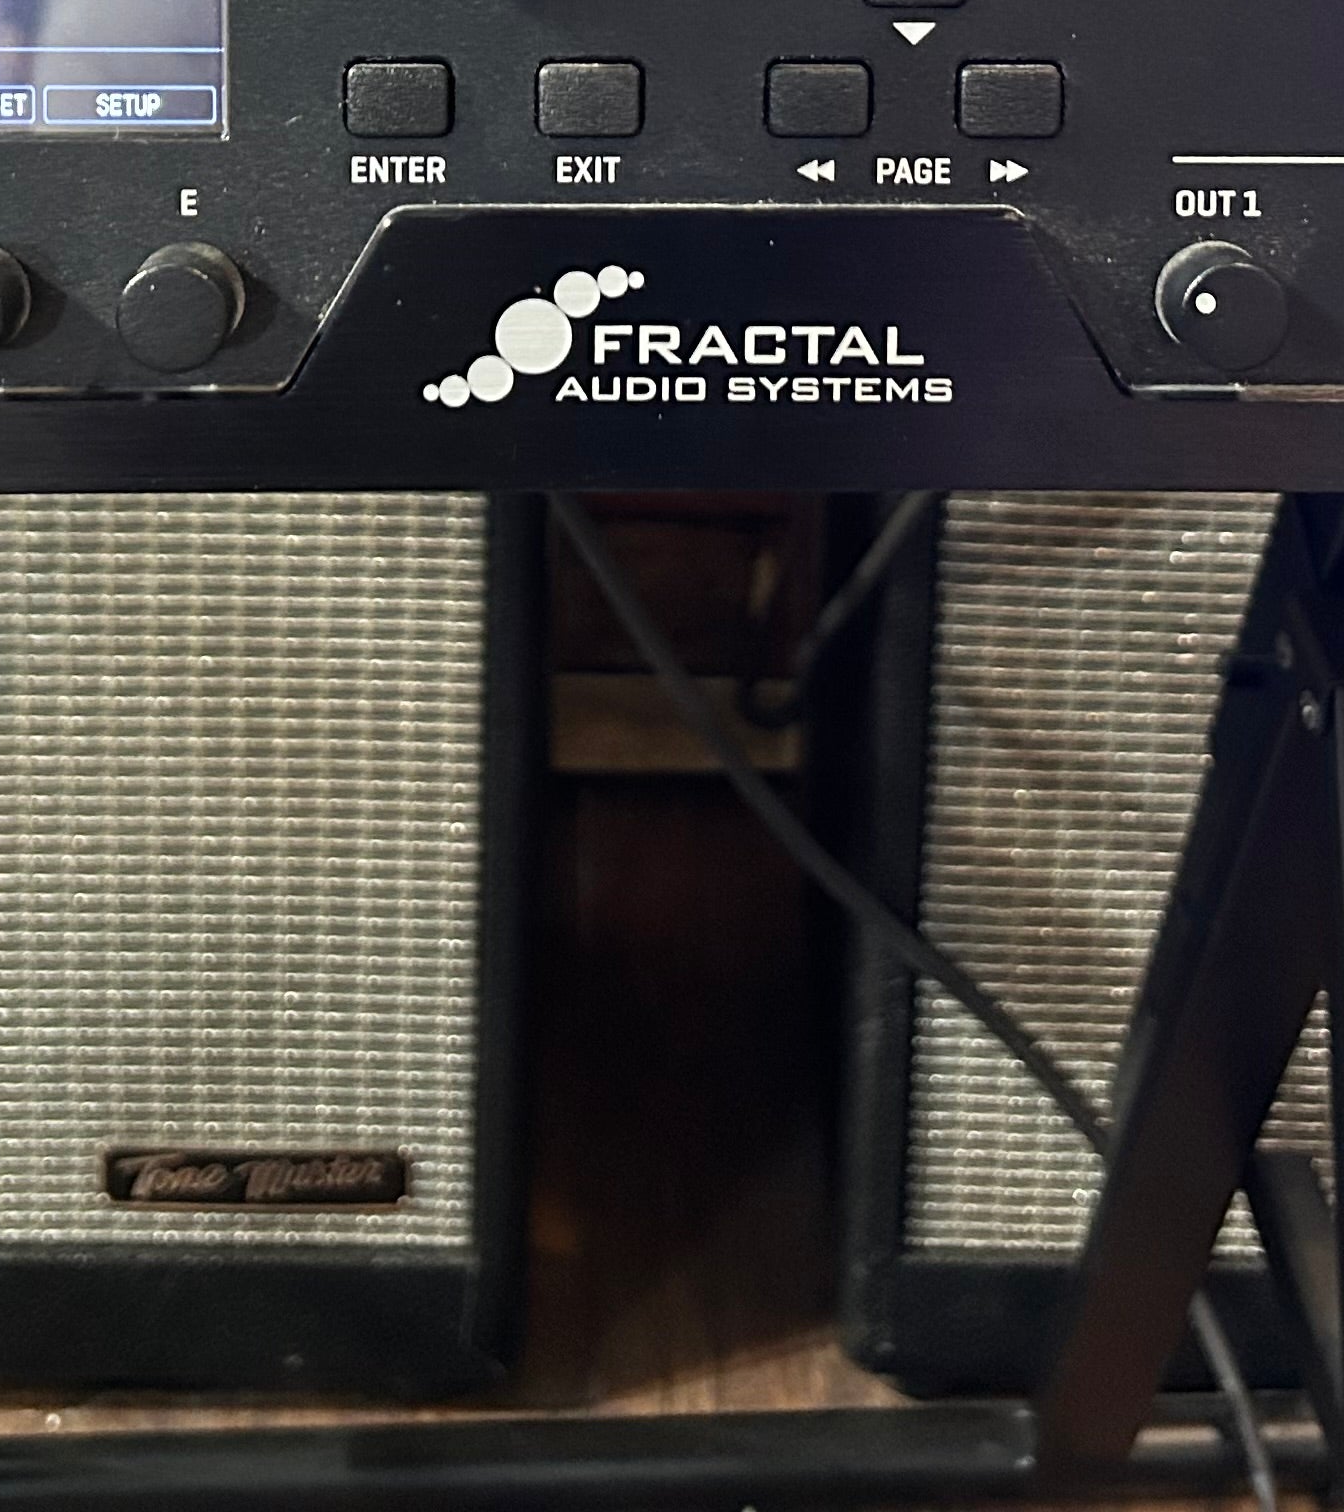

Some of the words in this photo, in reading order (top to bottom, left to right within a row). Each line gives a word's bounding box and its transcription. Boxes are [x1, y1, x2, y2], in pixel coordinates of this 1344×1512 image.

[96, 92, 161, 118] SETUP
[351, 155, 446, 184] ENTER
[556, 155, 621, 184] EXIT
[876, 157, 951, 186] PAGE
[180, 188, 199, 217] E
[1175, 189, 1238, 218] OUT
[1243, 189, 1262, 218] 1
[594, 324, 925, 366] FRACTAL
[555, 376, 707, 402] AUDIO
[727, 376, 954, 403] SYSTEMS
